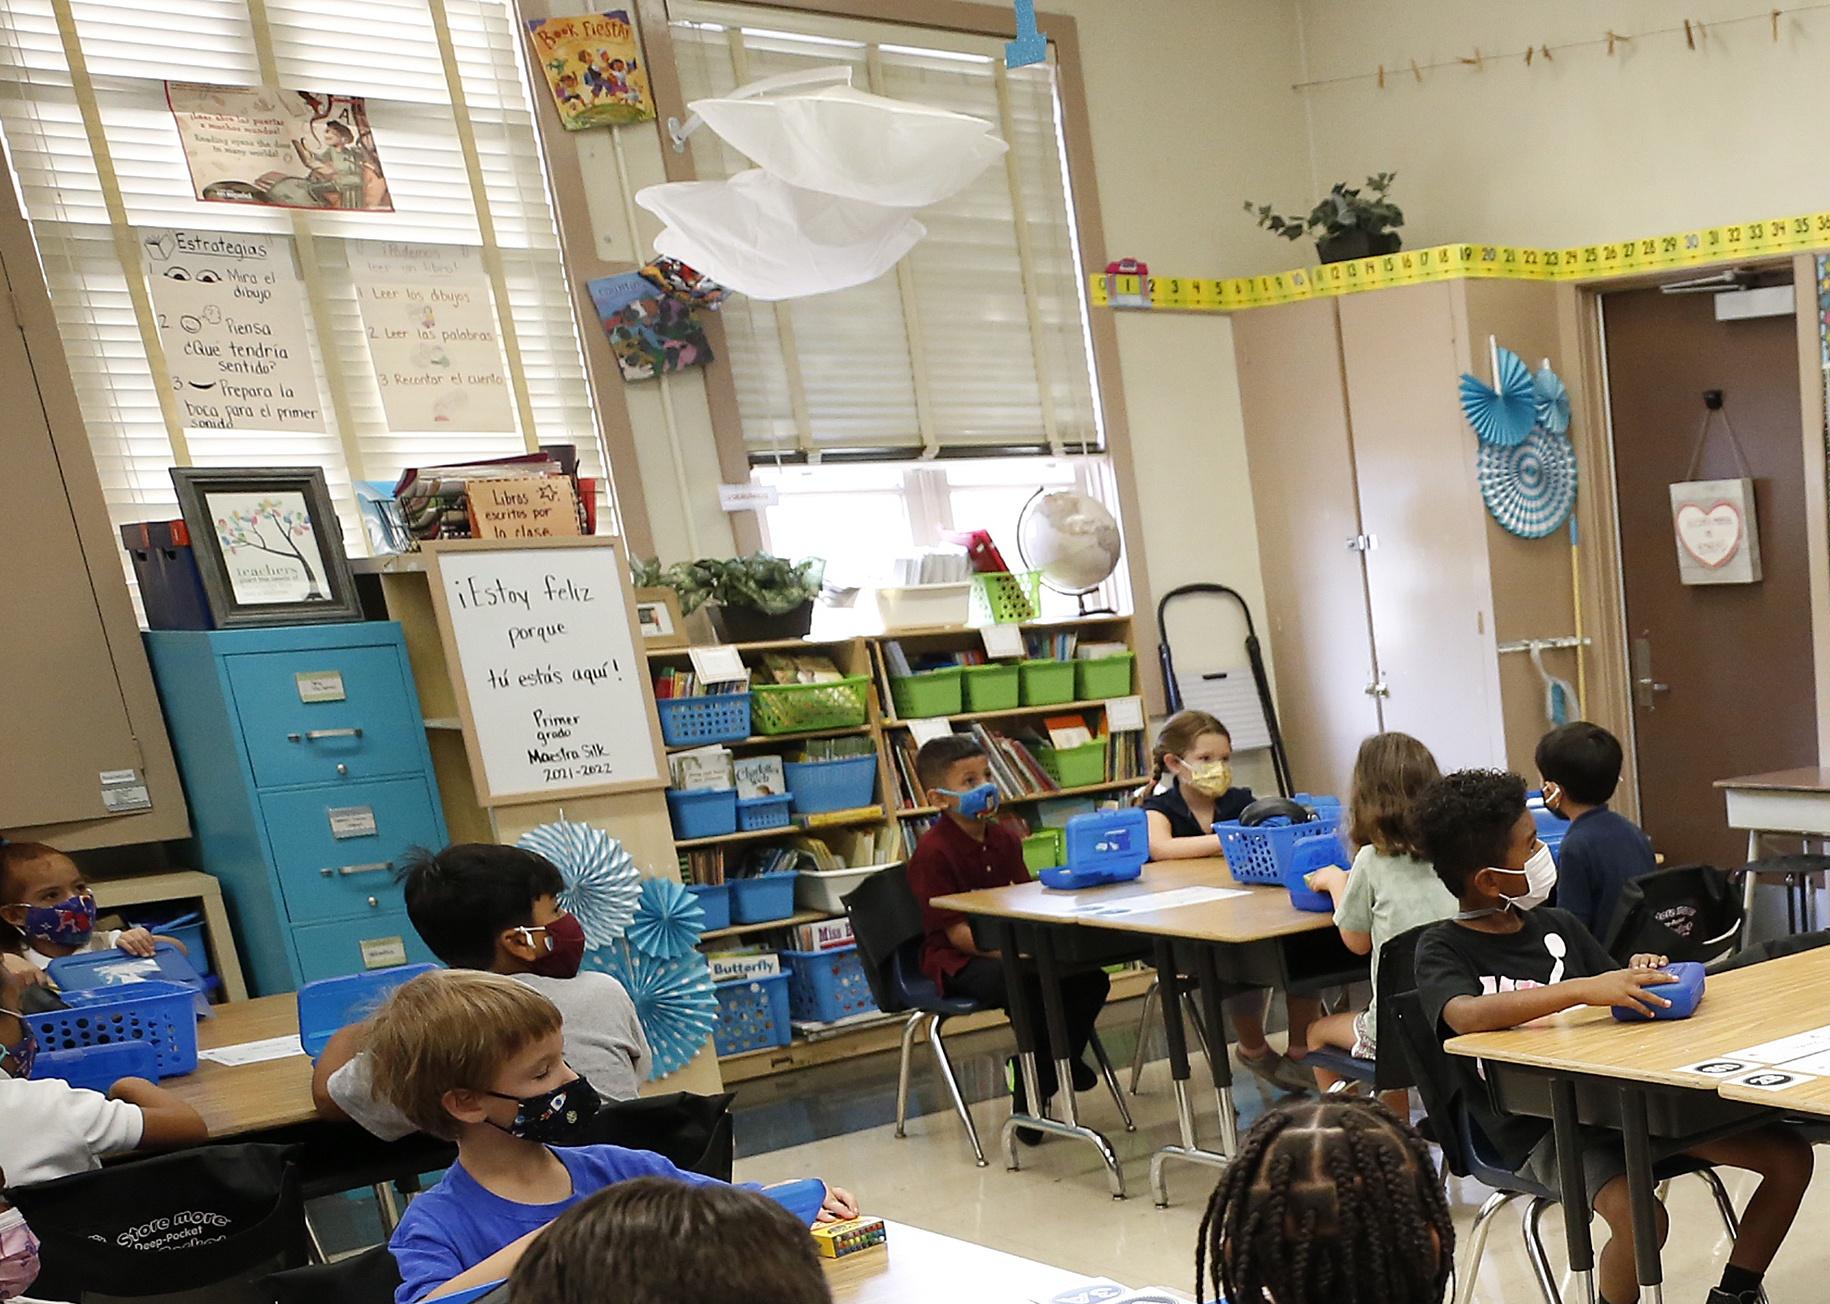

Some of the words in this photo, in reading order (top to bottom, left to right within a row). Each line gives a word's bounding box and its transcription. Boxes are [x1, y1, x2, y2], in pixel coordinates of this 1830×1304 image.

[176, 232, 268, 261] Estrategias
[227, 269, 258, 284] Mira
[264, 272, 276, 284] el
[234, 285, 271, 304] dibujo
[372, 288, 399, 300] Leer
[406, 288, 424, 301] los
[430, 288, 470, 308] dibujos
[225, 317, 272, 336] Piensa
[385, 328, 408, 340] Leer
[417, 328, 436, 340] las
[442, 328, 493, 343] palabras
[218, 360, 276, 374] sentido?
[394, 373, 442, 386] Recontar
[451, 373, 463, 384] el
[468, 373, 503, 385] cuento
[219, 379, 272, 401] Prepara
[280, 384, 294, 398] la
[184, 399, 219, 418] boca
[225, 405, 253, 422] para
[261, 404, 271, 418] el
[277, 407, 318, 421] primer
[191, 419, 233, 429] sonido
[492, 489, 529, 506] Libros
[485, 509, 527, 520] escritos
[533, 507, 552, 519] por
[494, 526, 506, 539] la
[237, 564, 298, 577] teachers
[454, 575, 531, 610] ¡Estoy
[544, 574, 594, 602] feliz
[508, 622, 568, 648] porque
[487, 668, 509, 690] tú
[518, 664, 563, 687] estás
[533, 709, 581, 728] Primer
[536, 728, 571, 746] grado
[527, 747, 580, 765] Maestra
[581, 744, 610, 760] Silk
[543, 763, 612, 782] 2021-2022
[818, 925, 841, 942] Miss
[714, 959, 774, 975] Butterfly
[117, 1218, 170, 1247] Store
[174, 1211, 228, 1226] more
[135, 1225, 203, 1251] Deep-Pocket
